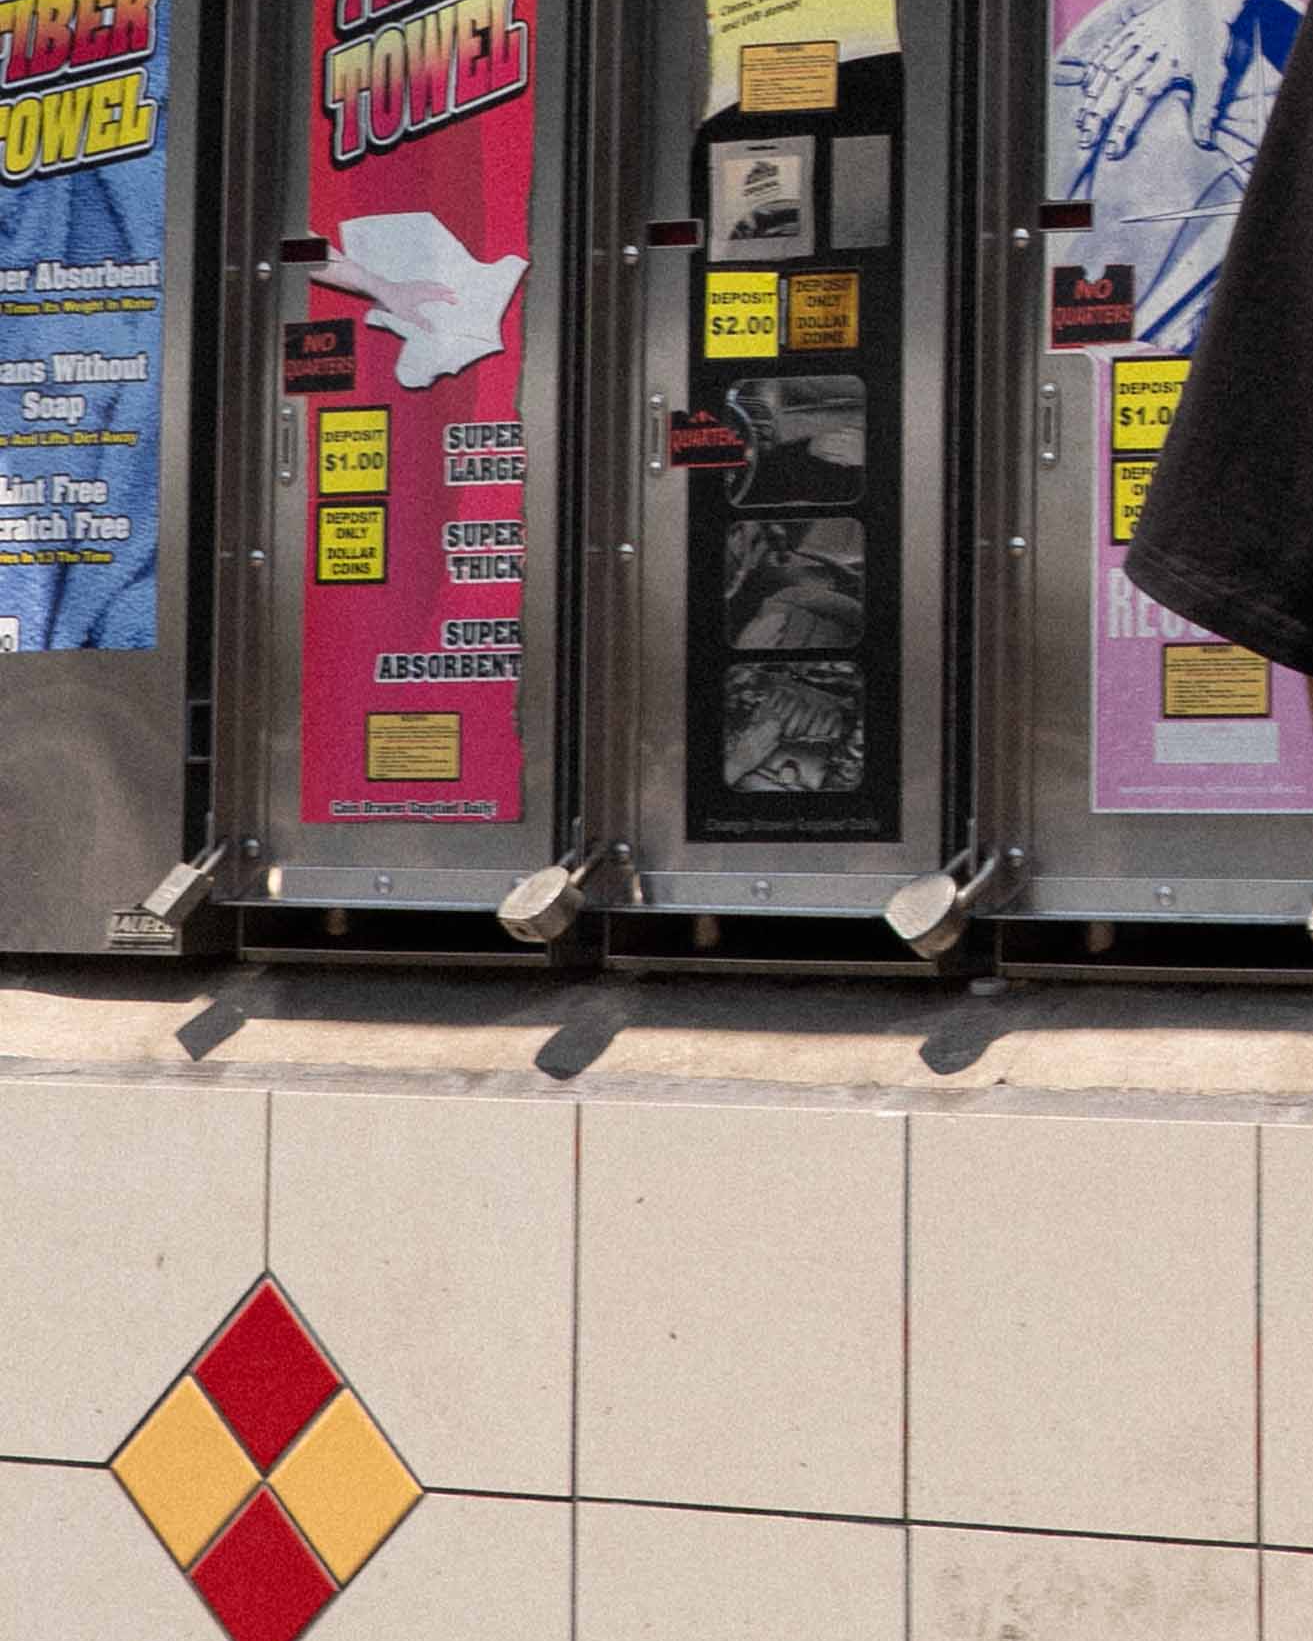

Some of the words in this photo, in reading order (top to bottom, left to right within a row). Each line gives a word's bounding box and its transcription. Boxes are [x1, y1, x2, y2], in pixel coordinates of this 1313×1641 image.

[0, 70, 155, 174] OWEL
[35, 259, 160, 291] Absorbent
[712, 291, 777, 305] DEPOSIT
[1074, 278, 1113, 299] NO
[712, 316, 775, 335] $2.00
[1054, 305, 1133, 325] QUARTERS
[303, 333, 338, 353] NO
[52, 351, 148, 383] Without
[22, 390, 86, 426] Soap
[1120, 407, 1173, 425] $1.0
[323, 429, 386, 443] DEPOSIT
[448, 424, 524, 451] SUPER
[324, 452, 386, 472] $1.00
[448, 453, 525, 483] LARGE
[0, 475, 46, 506] Lint
[52, 473, 108, 504] Free
[0, 510, 67, 541] ratch
[72, 509, 131, 540] Free
[325, 511, 381, 525] DEPOSIT
[335, 527, 368, 540] ONLY
[447, 521, 524, 548] SUPER
[326, 546, 378, 560] DOLLAR
[331, 562, 372, 576] COINS
[450, 555, 523, 582] THICK
[446, 621, 521, 647] SUPER
[378, 655, 521, 681] ABSORBENT
